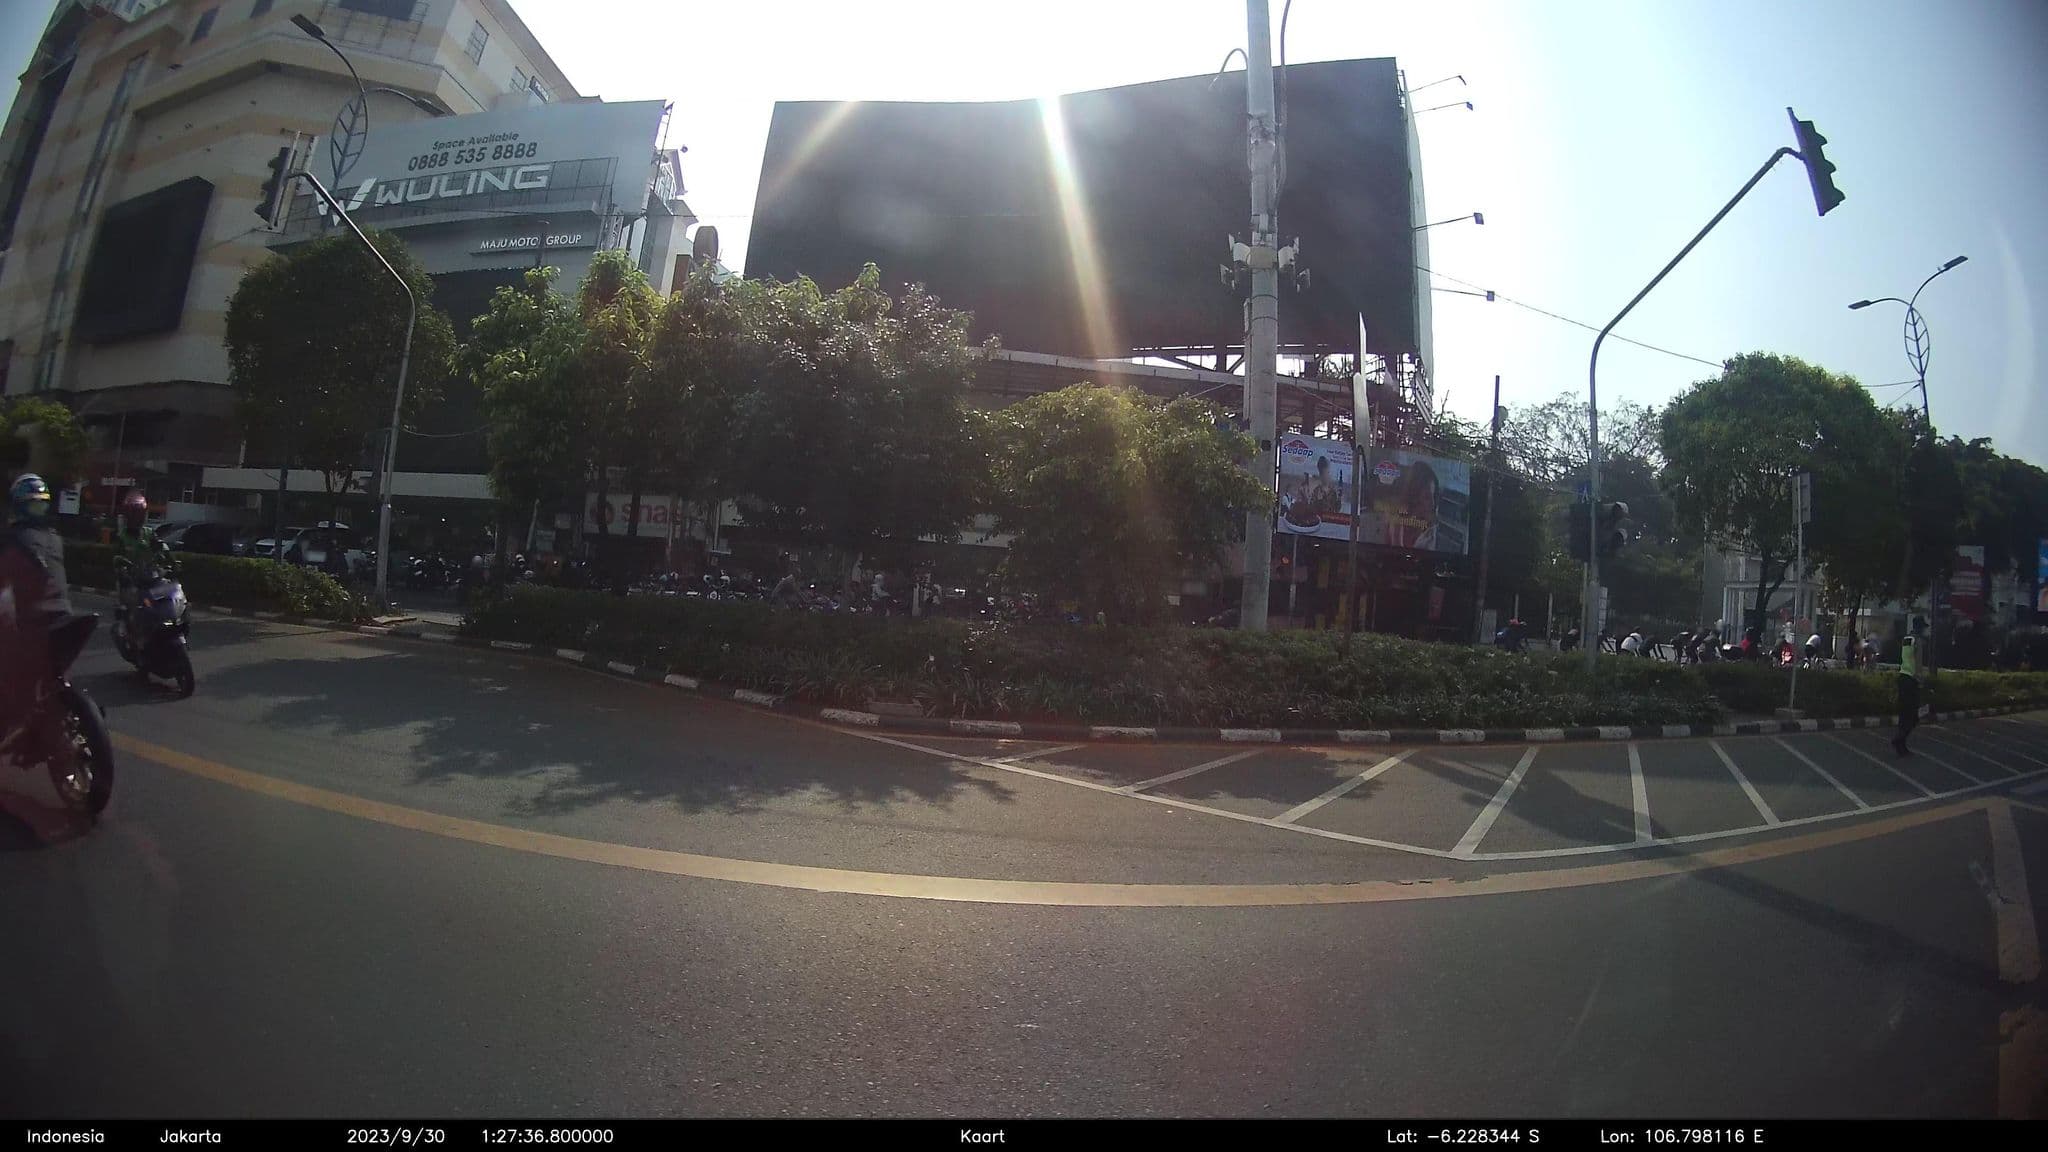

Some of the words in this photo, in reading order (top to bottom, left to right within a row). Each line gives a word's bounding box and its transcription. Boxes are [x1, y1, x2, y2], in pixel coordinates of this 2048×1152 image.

[432, 140, 464, 151] Space
[468, 132, 520, 146] Available
[408, 152, 449, 171] 0888
[454, 147, 487, 164] 535
[492, 142, 537, 160] 8888
[375, 165, 552, 207] WULING
[480, 238, 508, 249] MAJU
[546, 234, 582, 245] GROUP
